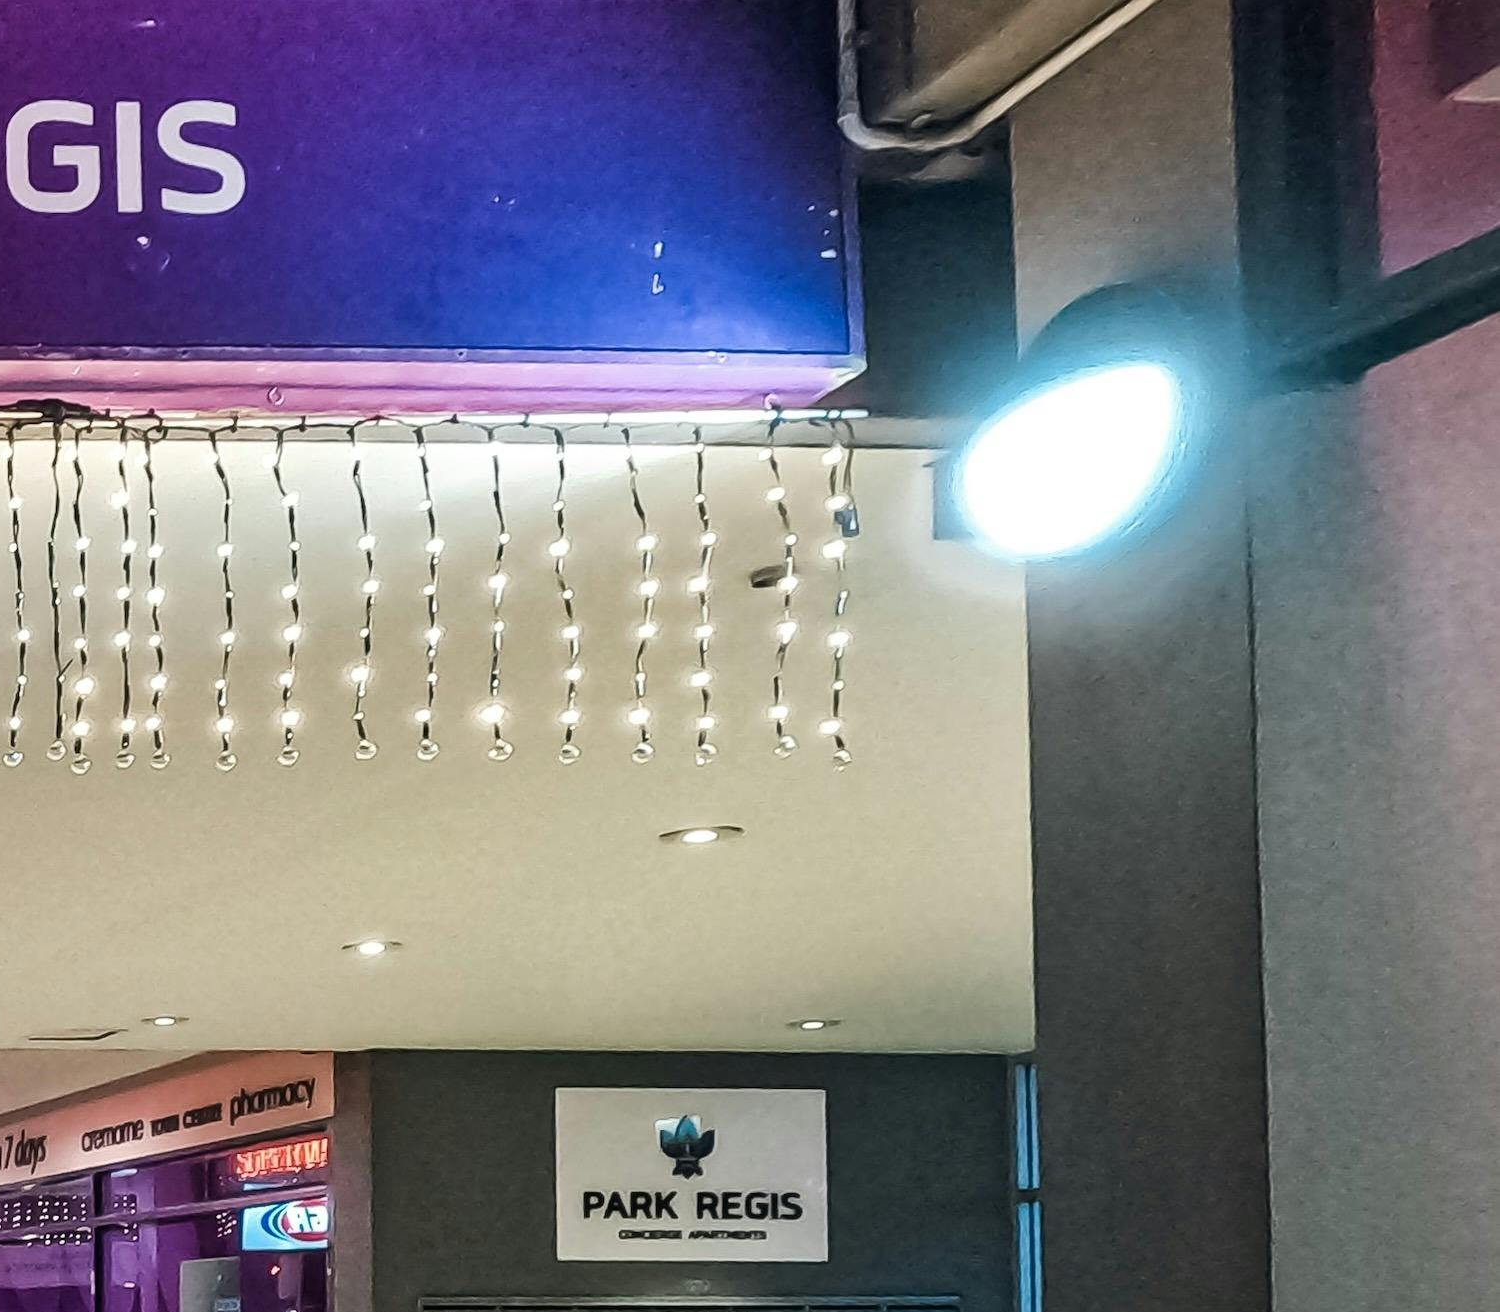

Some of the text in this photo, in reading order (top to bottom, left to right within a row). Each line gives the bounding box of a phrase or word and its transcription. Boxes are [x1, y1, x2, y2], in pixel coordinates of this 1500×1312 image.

[229, 1076, 316, 1127] pharmacy
[3, 1135, 14, 1170] 7
[15, 1129, 48, 1175] days
[583, 1191, 804, 1220] PARK REGIS
